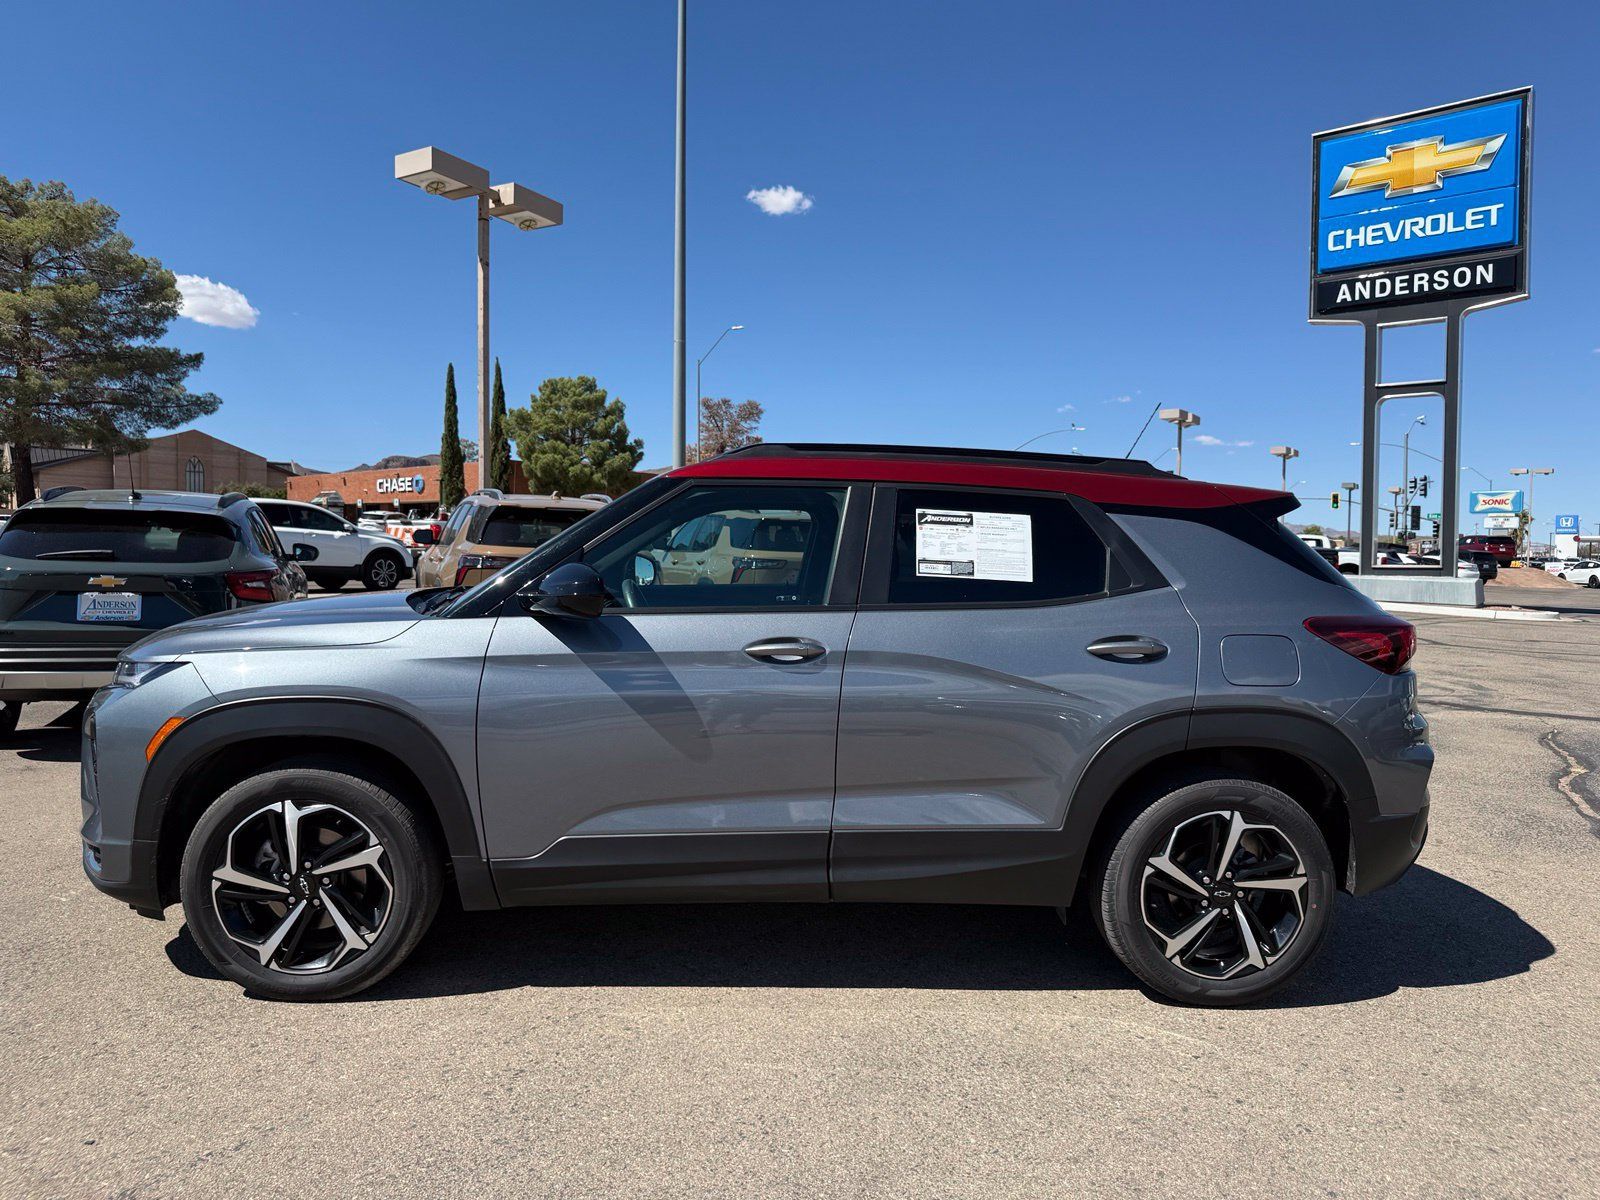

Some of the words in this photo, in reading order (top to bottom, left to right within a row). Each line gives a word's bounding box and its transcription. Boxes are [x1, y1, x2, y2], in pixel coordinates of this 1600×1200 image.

[1327, 203, 1504, 252] CHEVROLET
[1335, 263, 1494, 304] ANDERSON
[377, 477, 412, 493] CHASE
[82, 598, 137, 615] ANDERSON
